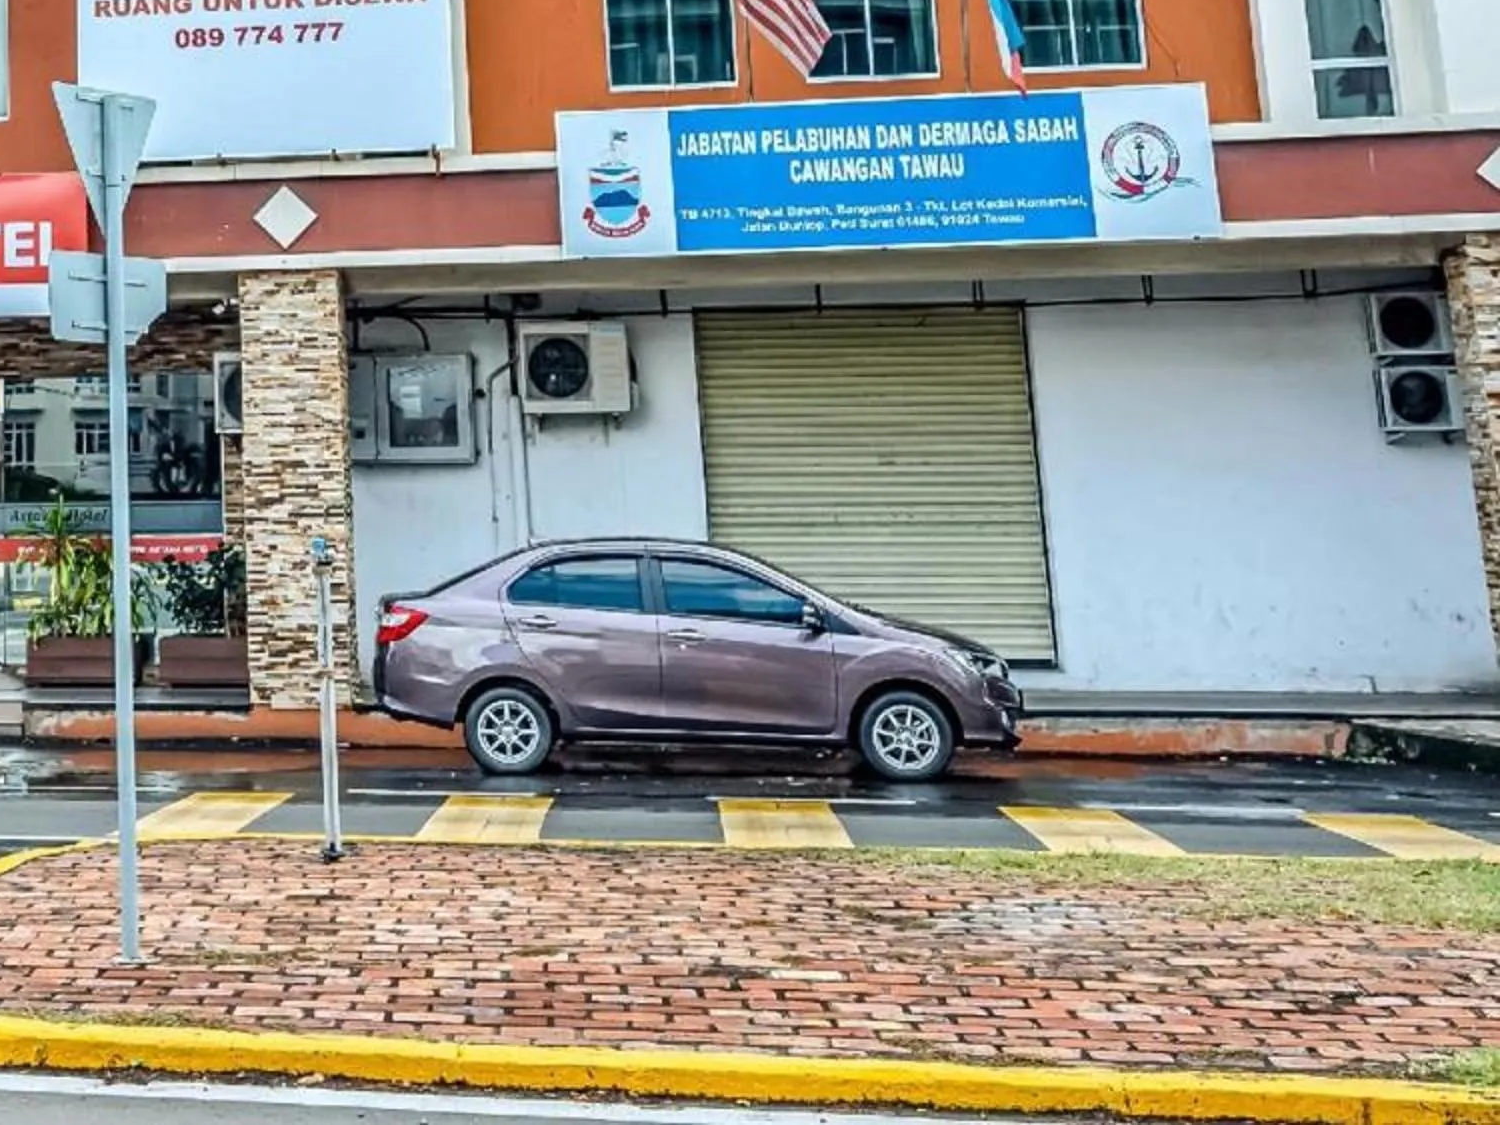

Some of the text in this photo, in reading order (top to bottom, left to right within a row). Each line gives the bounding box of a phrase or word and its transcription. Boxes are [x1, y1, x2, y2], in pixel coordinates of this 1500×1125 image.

[174, 21, 346, 50] 089 774 777
[677, 116, 1080, 157] JABATAN PELABUHAN DAN DERMAGA SABAH
[789, 153, 966, 184] CAWANGAN TAWAU
